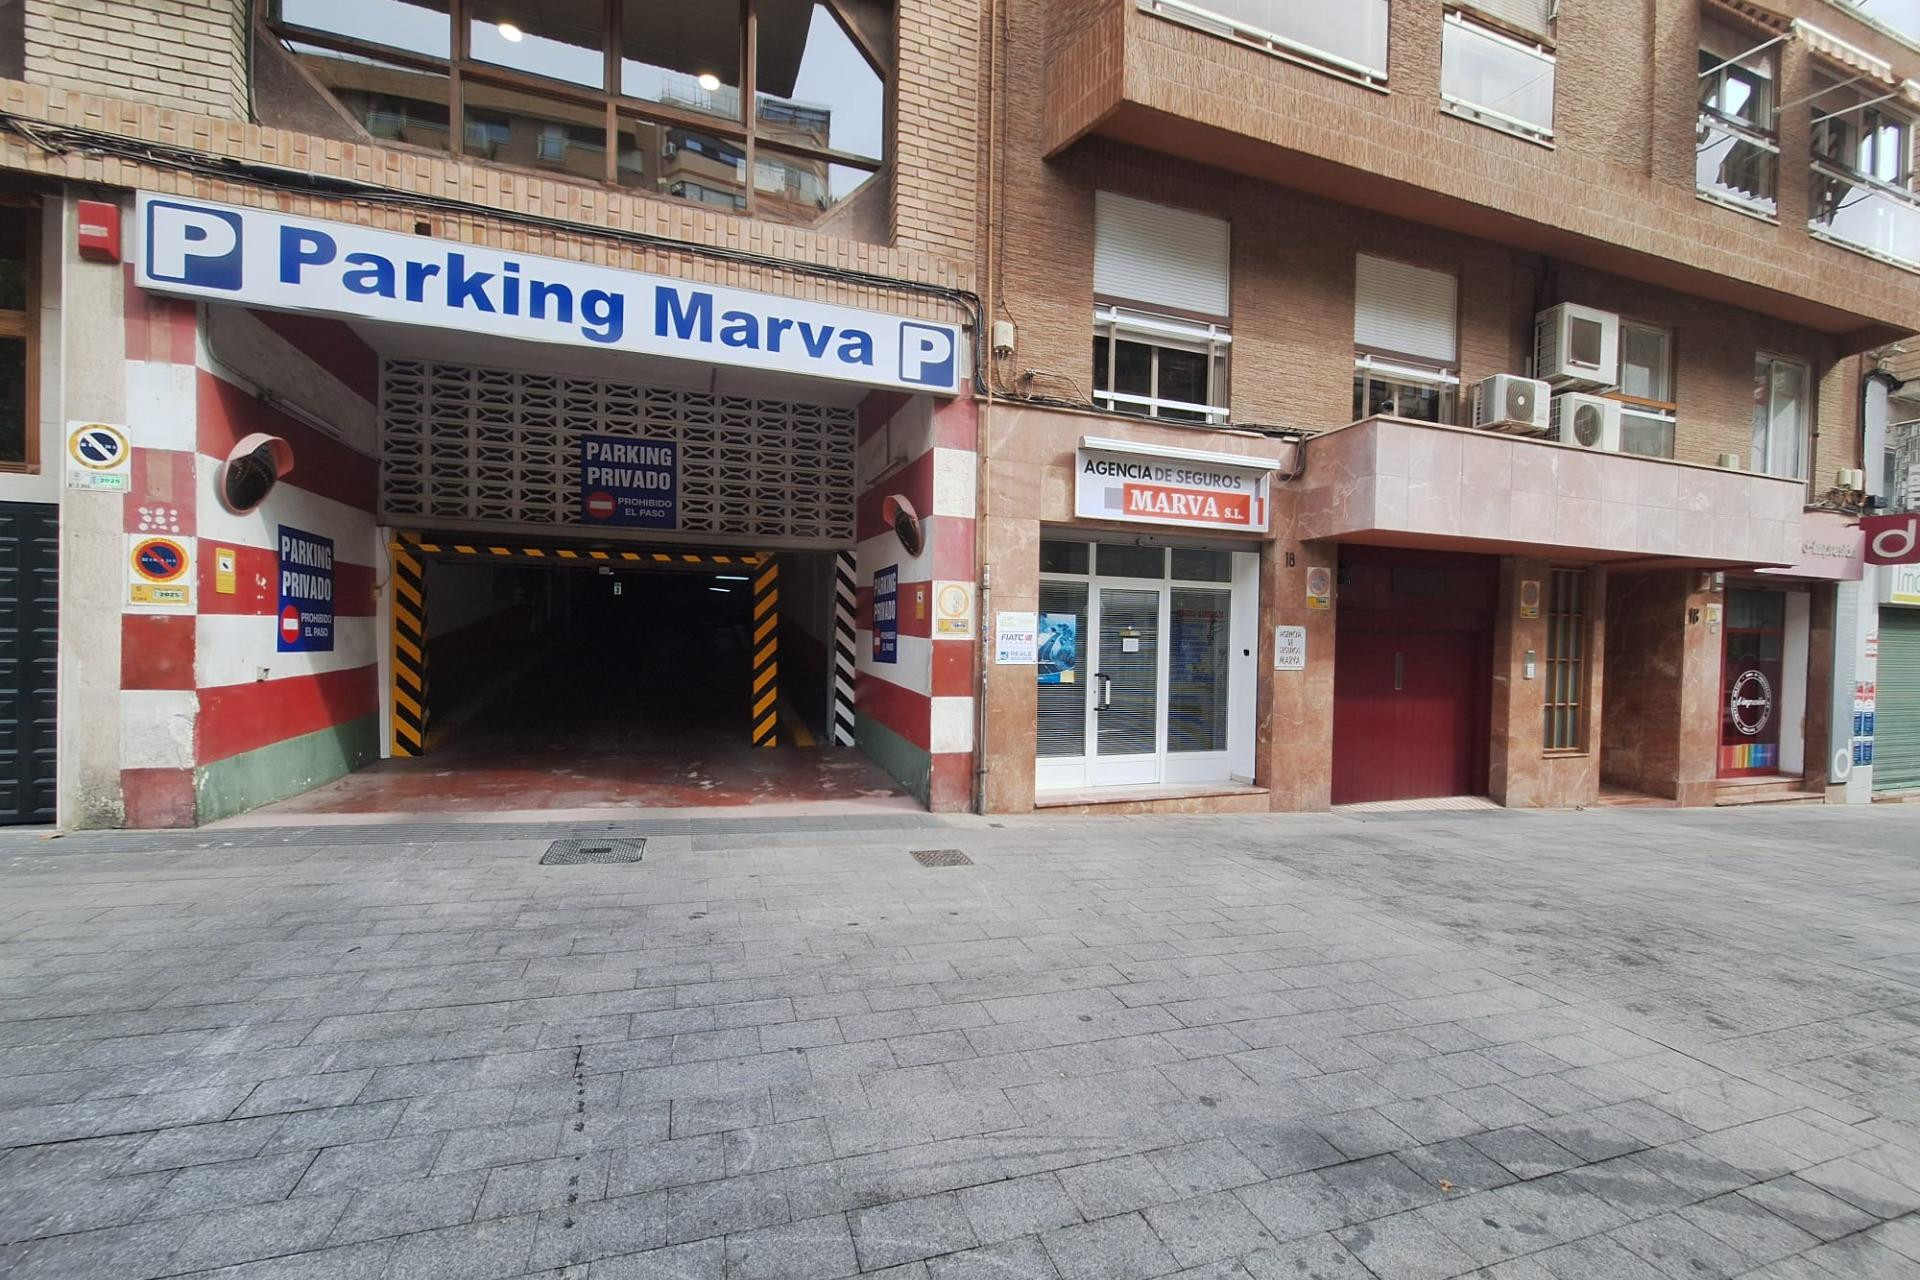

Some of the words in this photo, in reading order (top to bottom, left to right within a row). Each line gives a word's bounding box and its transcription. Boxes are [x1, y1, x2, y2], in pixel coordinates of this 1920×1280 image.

[153, 205, 236, 279] P
[279, 225, 624, 344] Parking
[654, 285, 874, 366] Marva
[902, 325, 951, 381] P
[586, 441, 672, 466] PARKING
[587, 466, 671, 490] PRIVADO
[1084, 459, 1152, 480] AGENCIA
[1154, 467, 1172, 482] DE
[1176, 470, 1241, 489] SEGUROS
[617, 497, 672, 508] PROHIBIDO
[625, 508, 637, 516] EL
[640, 509, 665, 517] PASO
[1129, 489, 1220, 518] MARVA
[1224, 507, 1244, 519] S.L.
[282, 535, 332, 570] PARKING
[1285, 551, 1296, 568] 18
[283, 570, 332, 601] PRIVADO
[301, 612, 332, 624] PROHIBIDO
[305, 627, 313, 637] EL
[313, 627, 328, 638] PASO
